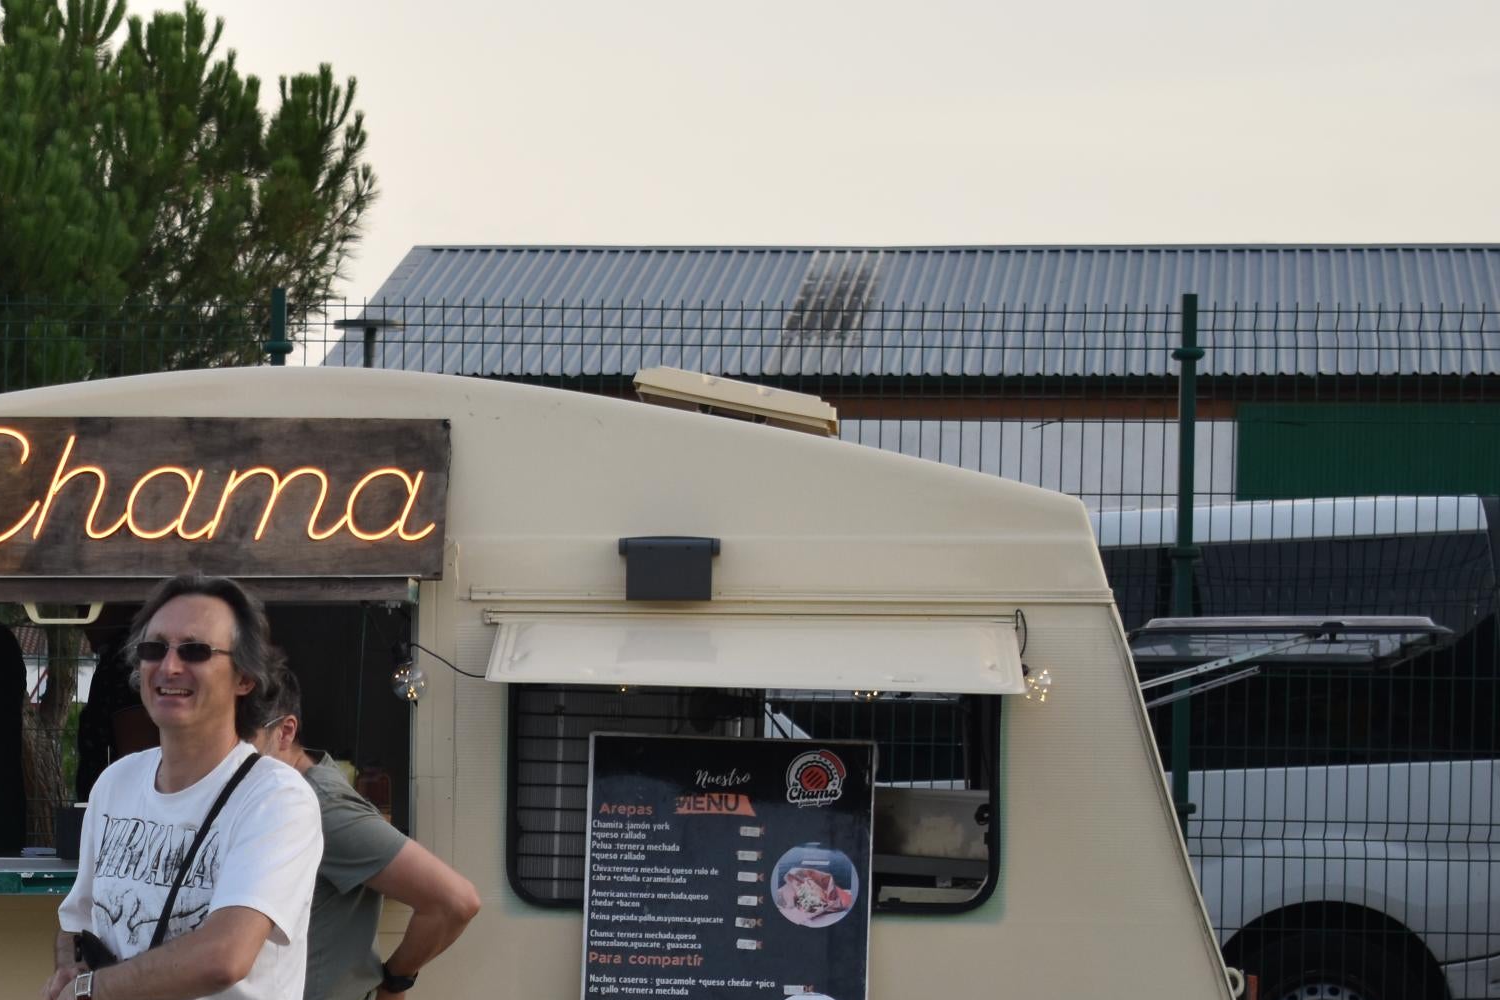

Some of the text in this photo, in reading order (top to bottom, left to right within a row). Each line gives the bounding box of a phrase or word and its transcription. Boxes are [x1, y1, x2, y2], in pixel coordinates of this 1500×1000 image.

[694, 768, 751, 788] Nuestro
[789, 788, 841, 801] Chama
[599, 803, 653, 817] Arepas
[592, 820, 623, 829] Chamita
[652, 821, 670, 831] york
[620, 831, 646, 839] rallado
[591, 840, 612, 850] Pelua
[646, 842, 680, 852] mechada
[620, 852, 646, 860] rallado
[640, 866, 670, 874] mechada
[672, 867, 693, 876] queso
[694, 867, 709, 875] rulo
[710, 867, 719, 875] de
[642, 875, 687, 884] caramelizada
[591, 899, 614, 907] chedar
[590, 912, 610, 920] Reina
[589, 930, 614, 938] Chama:
[617, 931, 643, 939] ternera
[666, 942, 702, 950] guasacaca
[588, 952, 622, 964] Para
[589, 974, 616, 983] Nachos
[618, 976, 648, 984] caseros
[655, 977, 696, 987] guacamole
[727, 978, 752, 987] chedar
[589, 985, 599, 993] de
[600, 985, 619, 995] gallo
[655, 987, 689, 996] mechada
